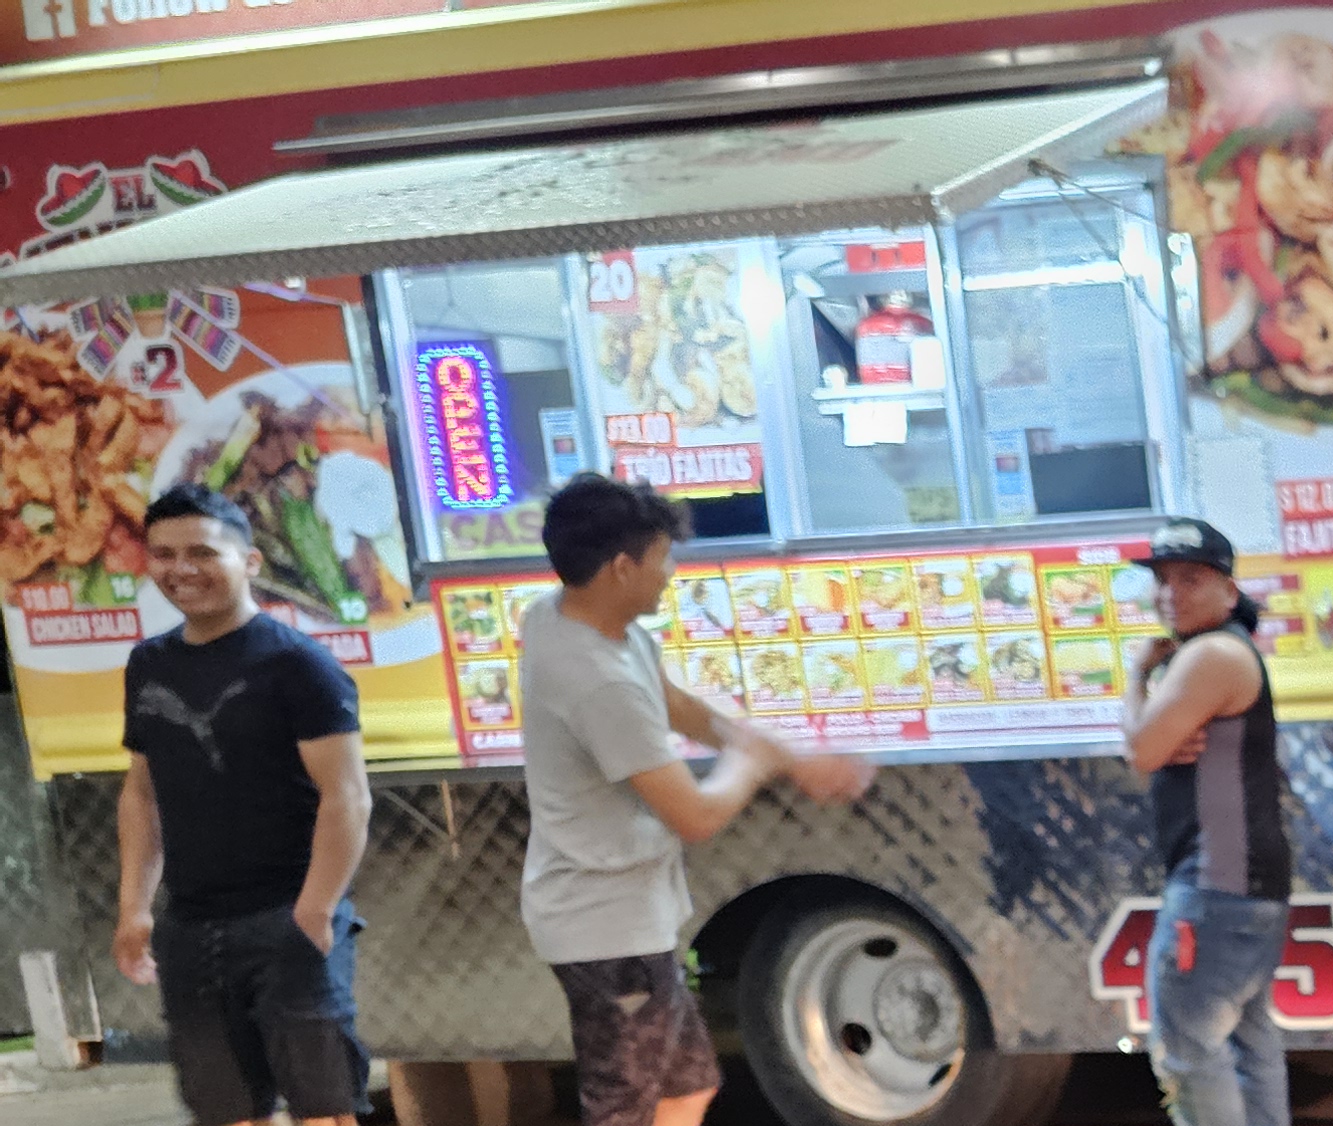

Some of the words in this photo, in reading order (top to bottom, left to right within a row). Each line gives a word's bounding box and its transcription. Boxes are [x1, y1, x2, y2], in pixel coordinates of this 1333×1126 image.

[589, 260, 634, 302] 20
[435, 357, 493, 501] OPEN
[450, 511, 544, 551] CAS
[31, 613, 91, 642] CHICKEN
[91, 610, 138, 640] SALAD
